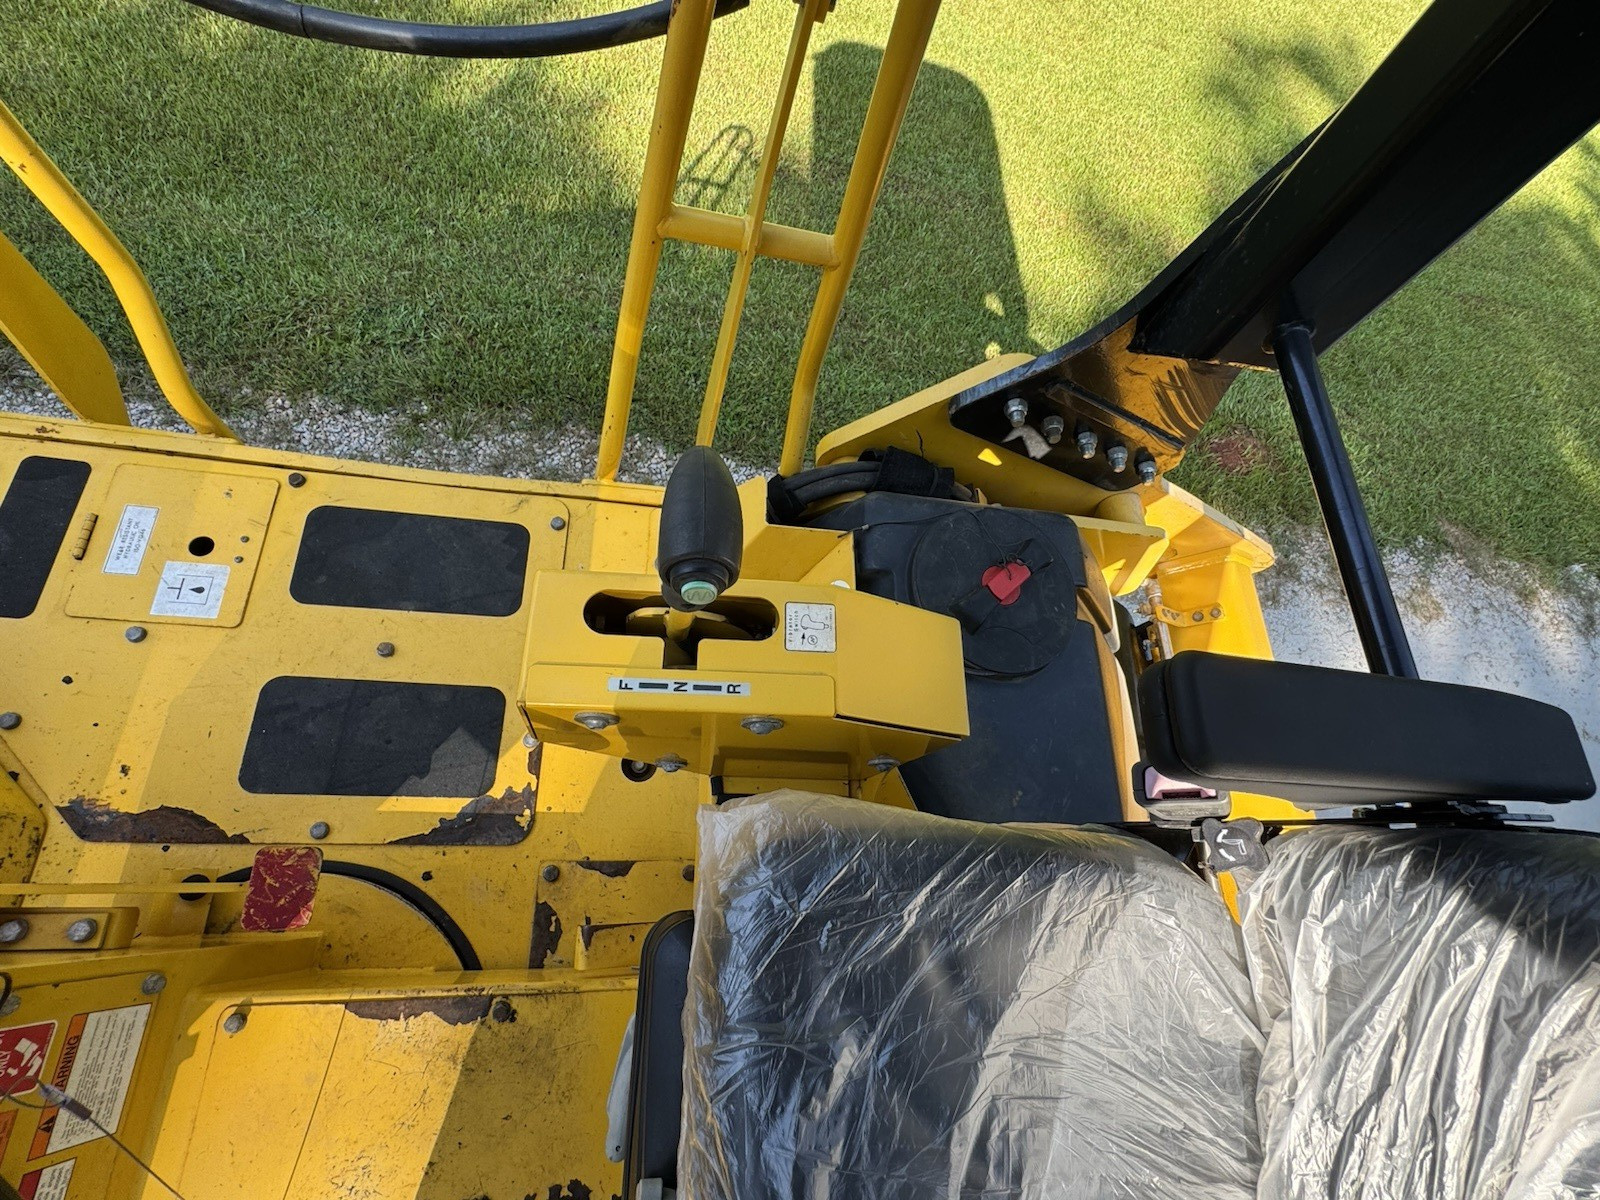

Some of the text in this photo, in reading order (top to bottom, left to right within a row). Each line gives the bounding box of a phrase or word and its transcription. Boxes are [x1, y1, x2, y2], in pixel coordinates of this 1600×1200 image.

[114, 518, 133, 560] WEAR RESISTANT
[124, 530, 136, 559] HYDRAULIC
[619, 680, 741, 694] F N R
[55, 1035, 80, 1088] ARNING
